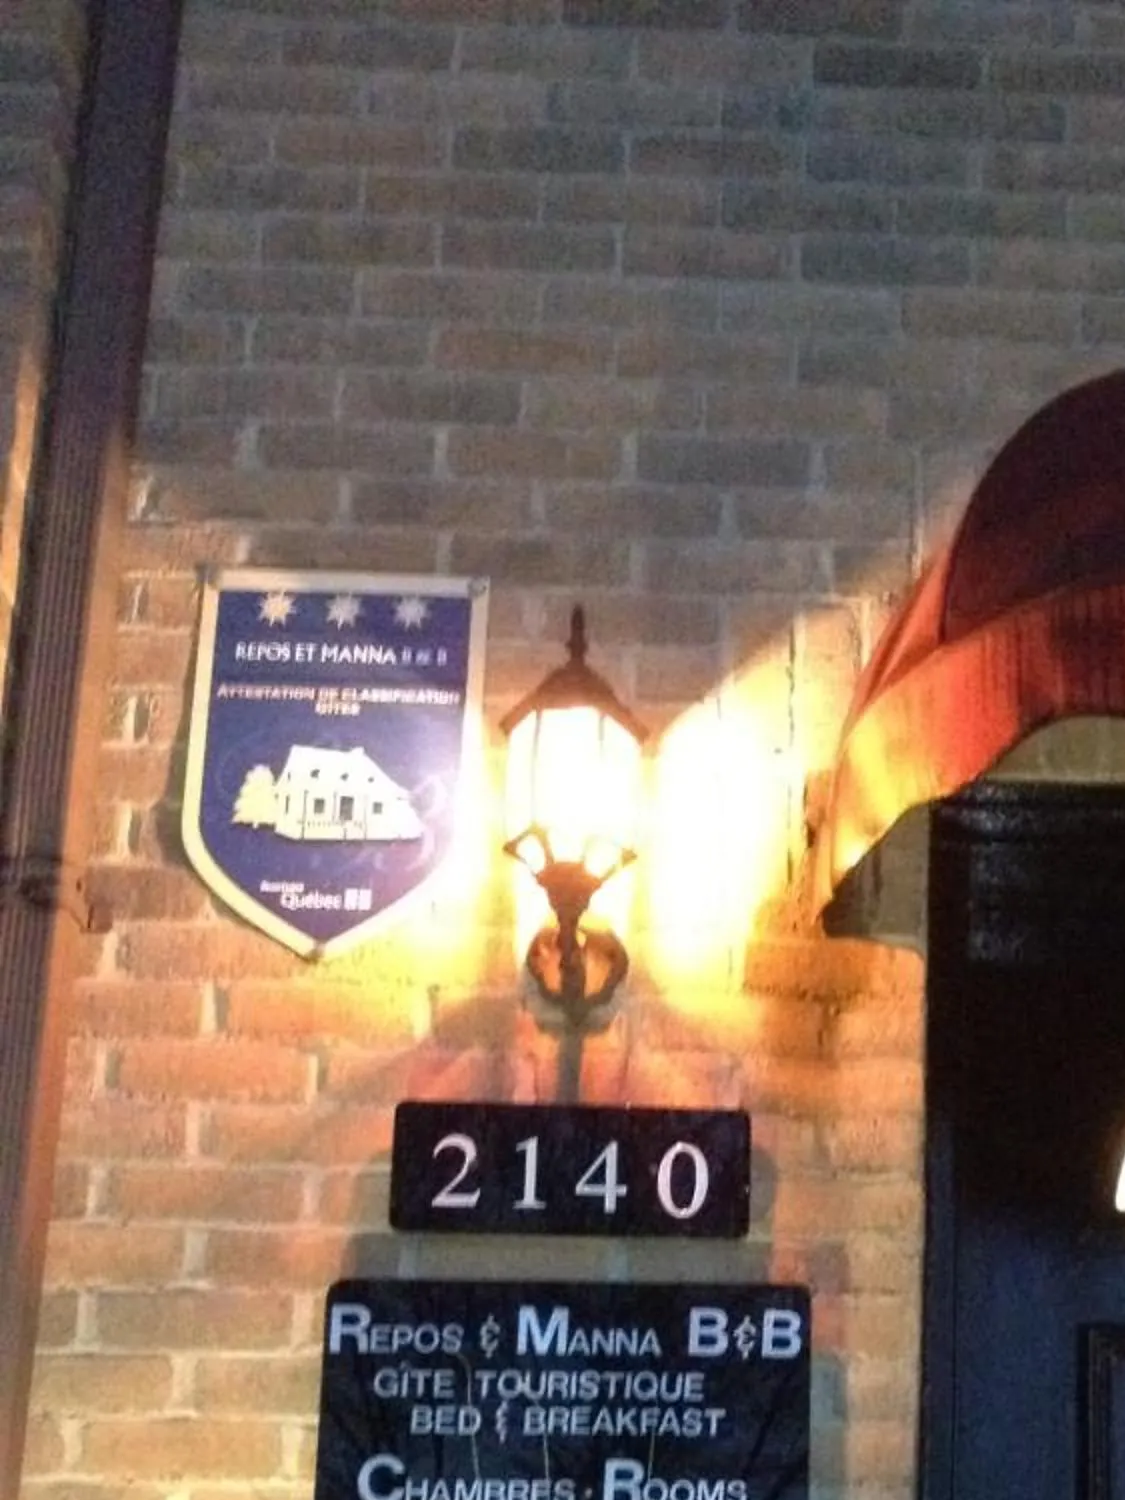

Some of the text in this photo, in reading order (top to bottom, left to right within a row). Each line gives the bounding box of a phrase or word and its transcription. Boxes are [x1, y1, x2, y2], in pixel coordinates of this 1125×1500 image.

[295, 642, 317, 663] ET
[320, 643, 397, 665] MANNA
[430, 1133, 710, 1219] 2140
[329, 1303, 465, 1355] REPOS
[516, 1305, 663, 1357] MANNA
[474, 1368, 705, 1403] TOURISTIQUE
[410, 1405, 483, 1437] BED
[523, 1406, 727, 1438] BREAKFAST
